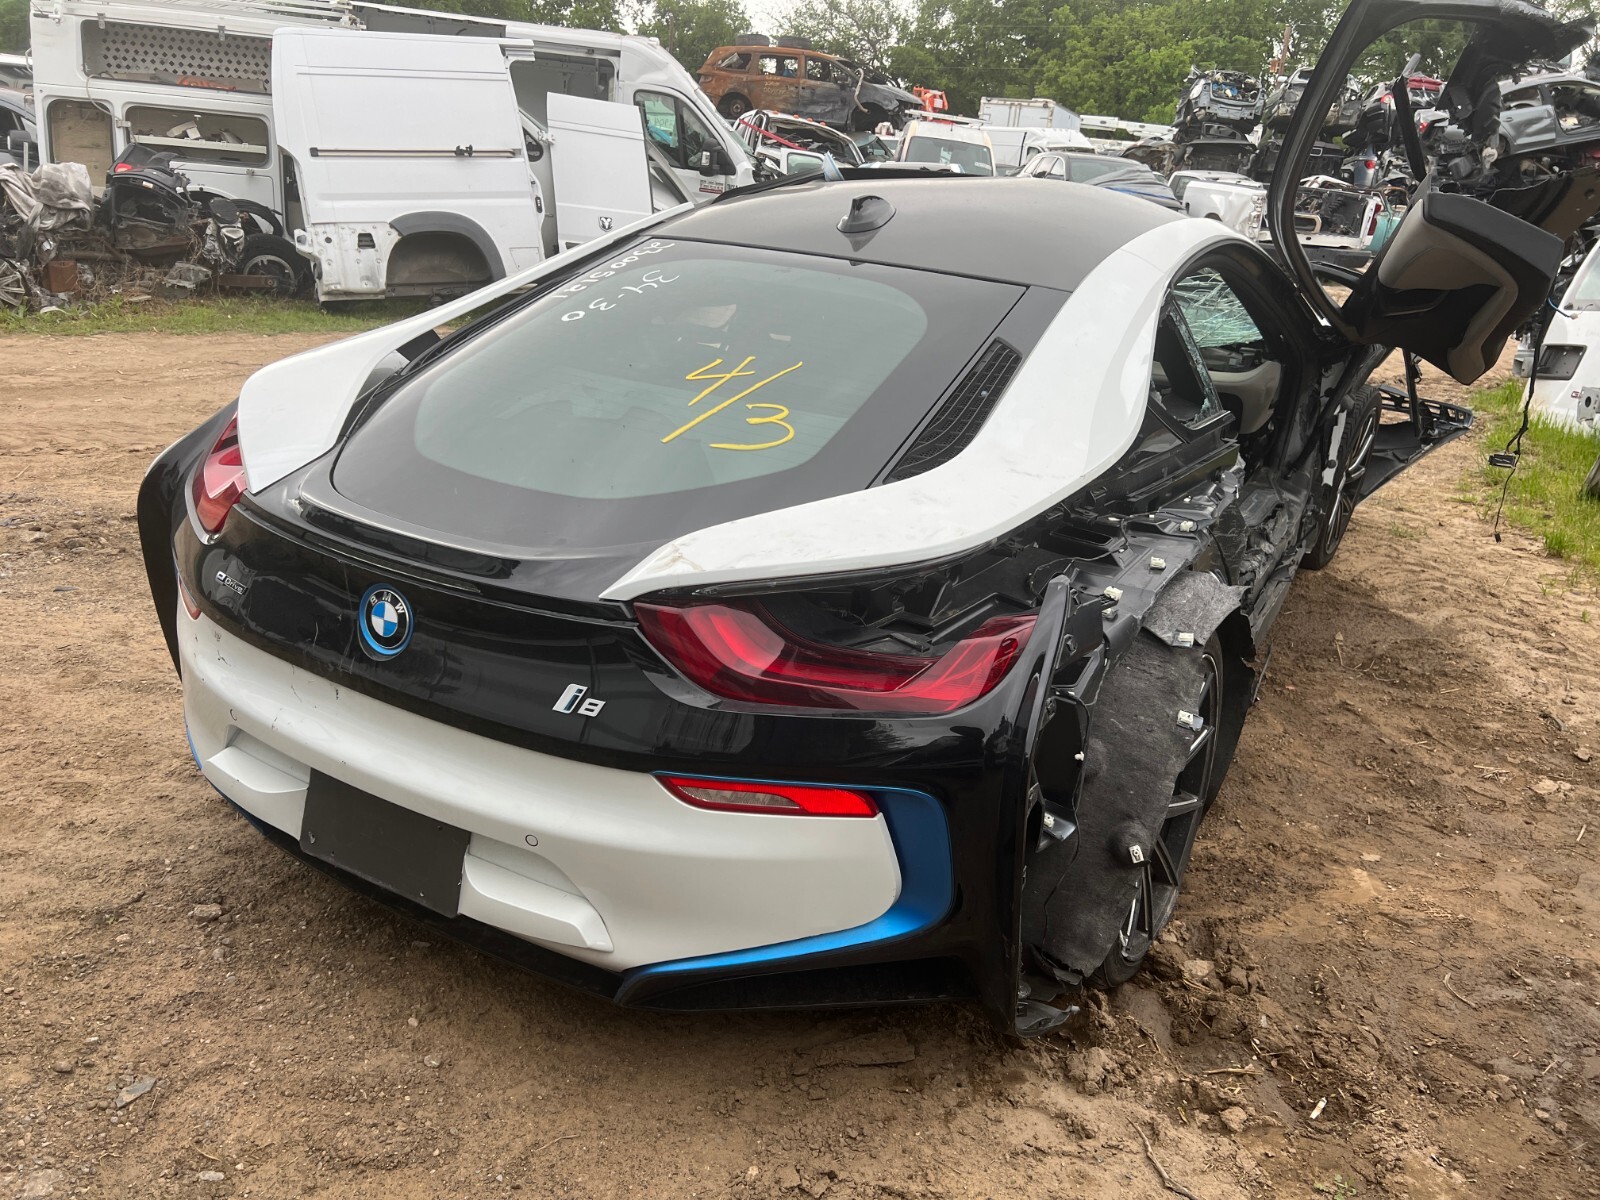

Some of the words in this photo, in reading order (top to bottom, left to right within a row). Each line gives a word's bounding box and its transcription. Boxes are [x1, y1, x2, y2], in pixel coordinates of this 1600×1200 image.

[660, 355, 803, 451] 4/3
[370, 591, 405, 614] BMW
[552, 683, 606, 717] i8
